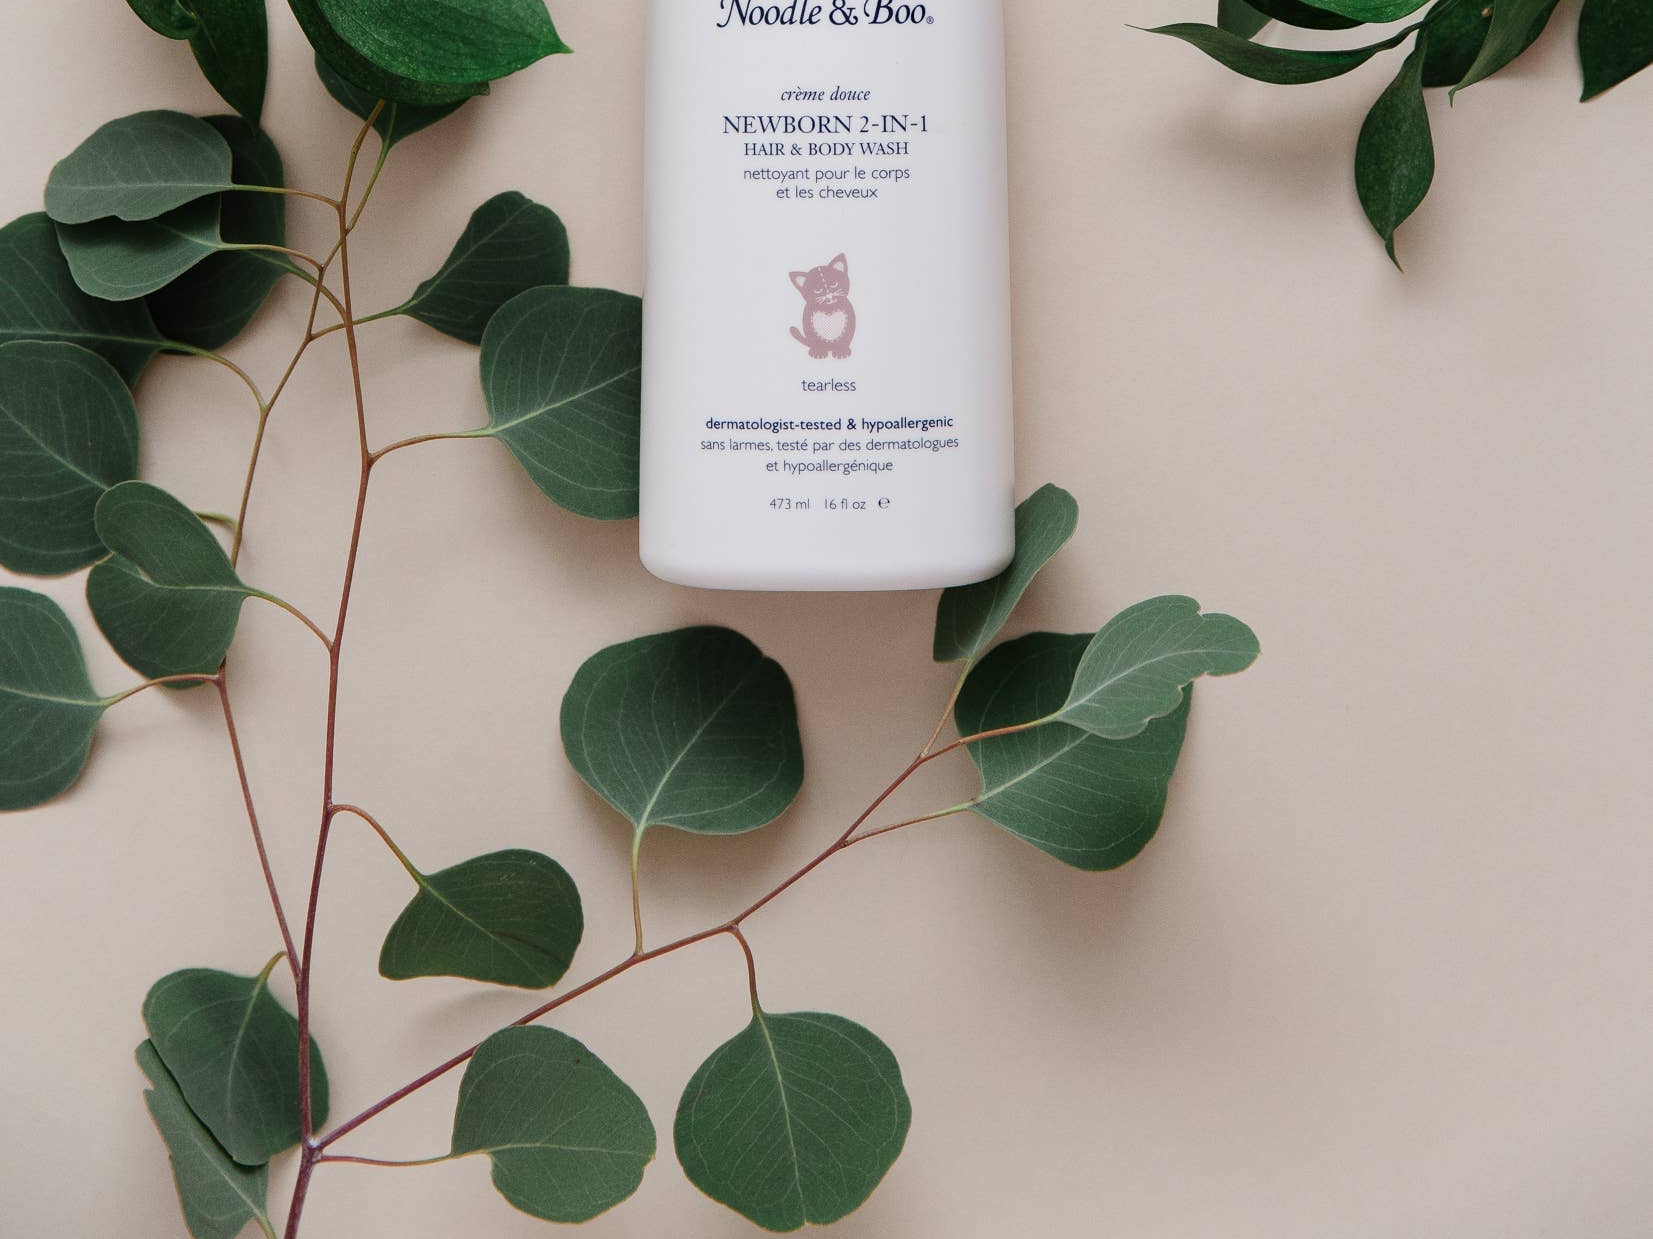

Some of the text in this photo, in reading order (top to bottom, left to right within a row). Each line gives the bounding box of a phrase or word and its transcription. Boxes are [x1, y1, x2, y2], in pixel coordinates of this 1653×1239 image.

[779, 85, 872, 103] crème douce
[722, 113, 928, 135] NEWBORN 2-IN-1
[744, 142, 910, 157] HAIR & BODY WASH
[744, 166, 912, 184] nettoyant pour le corps
[776, 185, 879, 200] et les cheveux
[800, 377, 856, 392] tearless
[704, 416, 953, 434] dermatologist-tested & hypoallergenic
[701, 437, 958, 454] sans larmes, testé par des dermatologues
[766, 459, 893, 475] et hypoallergénique
[770, 498, 793, 511] 473
[796, 498, 809, 510] ml
[825, 498, 837, 511] 16
[840, 497, 848, 510] fl
[851, 498, 866, 511] oz
